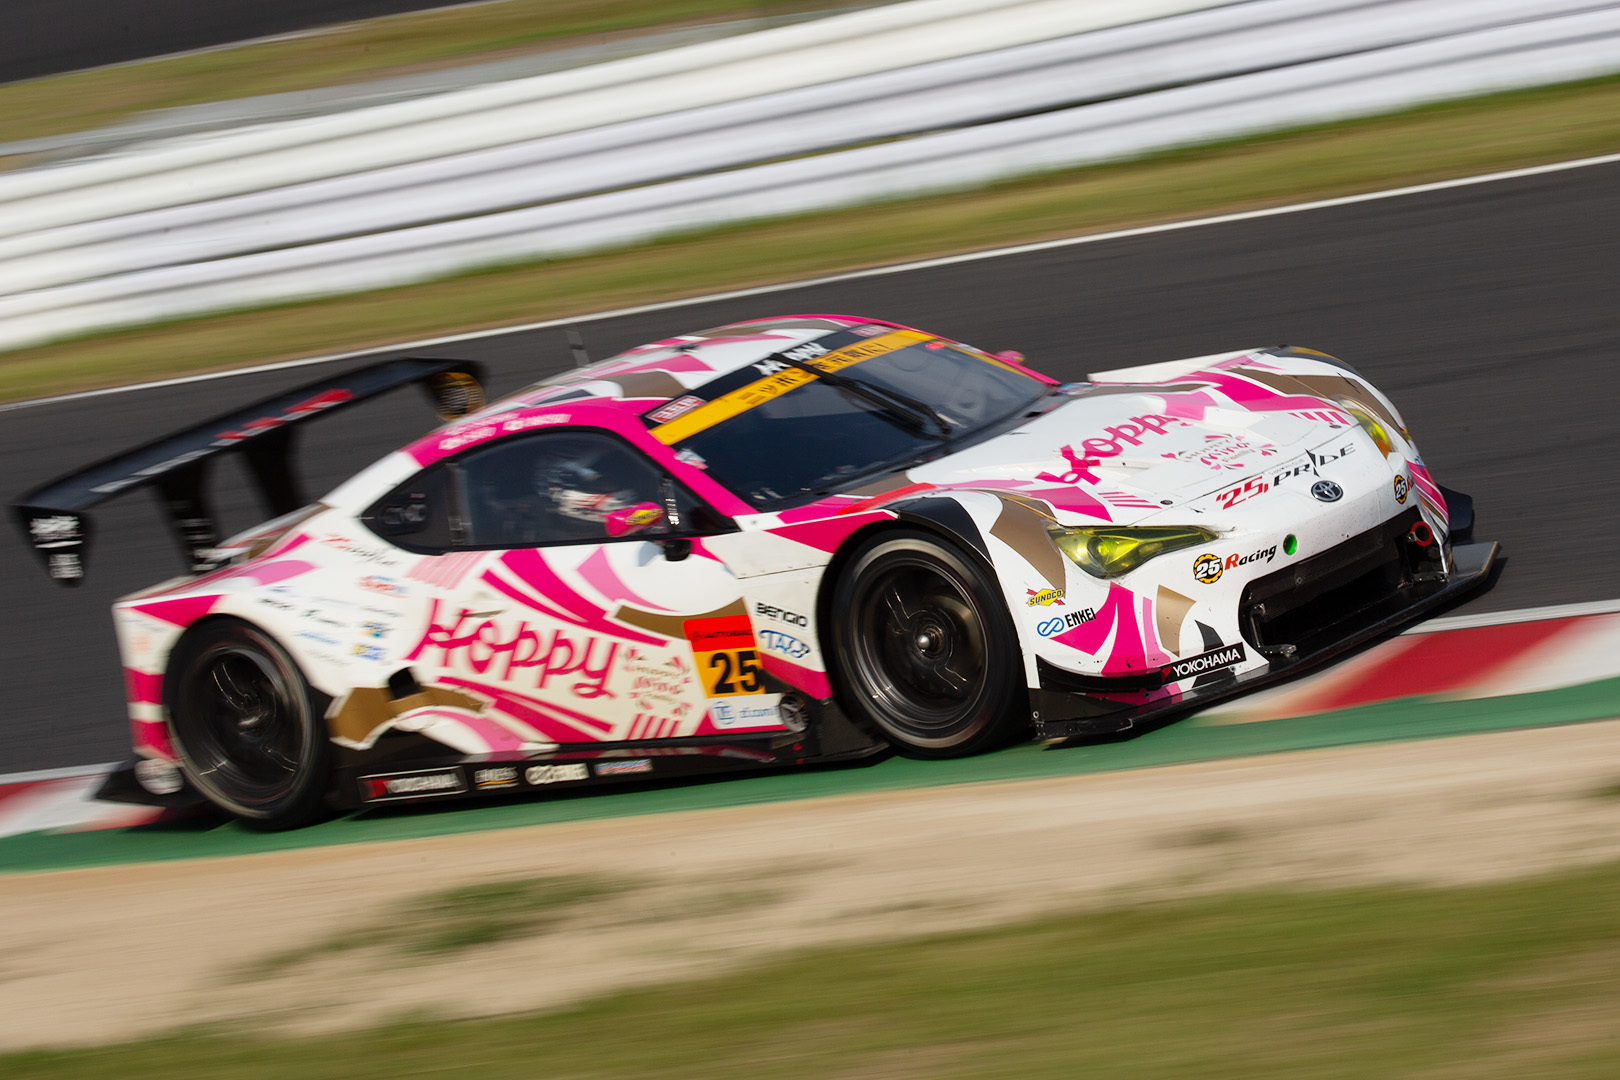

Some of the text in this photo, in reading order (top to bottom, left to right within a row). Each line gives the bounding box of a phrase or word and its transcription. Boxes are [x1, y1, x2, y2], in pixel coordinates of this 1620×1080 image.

[1273, 442, 1356, 487] PRIDE
[1194, 545, 1278, 580] 25 Racing
[1029, 589, 1062, 606] SUNOCO
[1064, 607, 1097, 628] ENKEI
[402, 598, 624, 699] Hoppy
[1172, 647, 1242, 678] YOKOHAMA
[710, 650, 761, 694] 25
